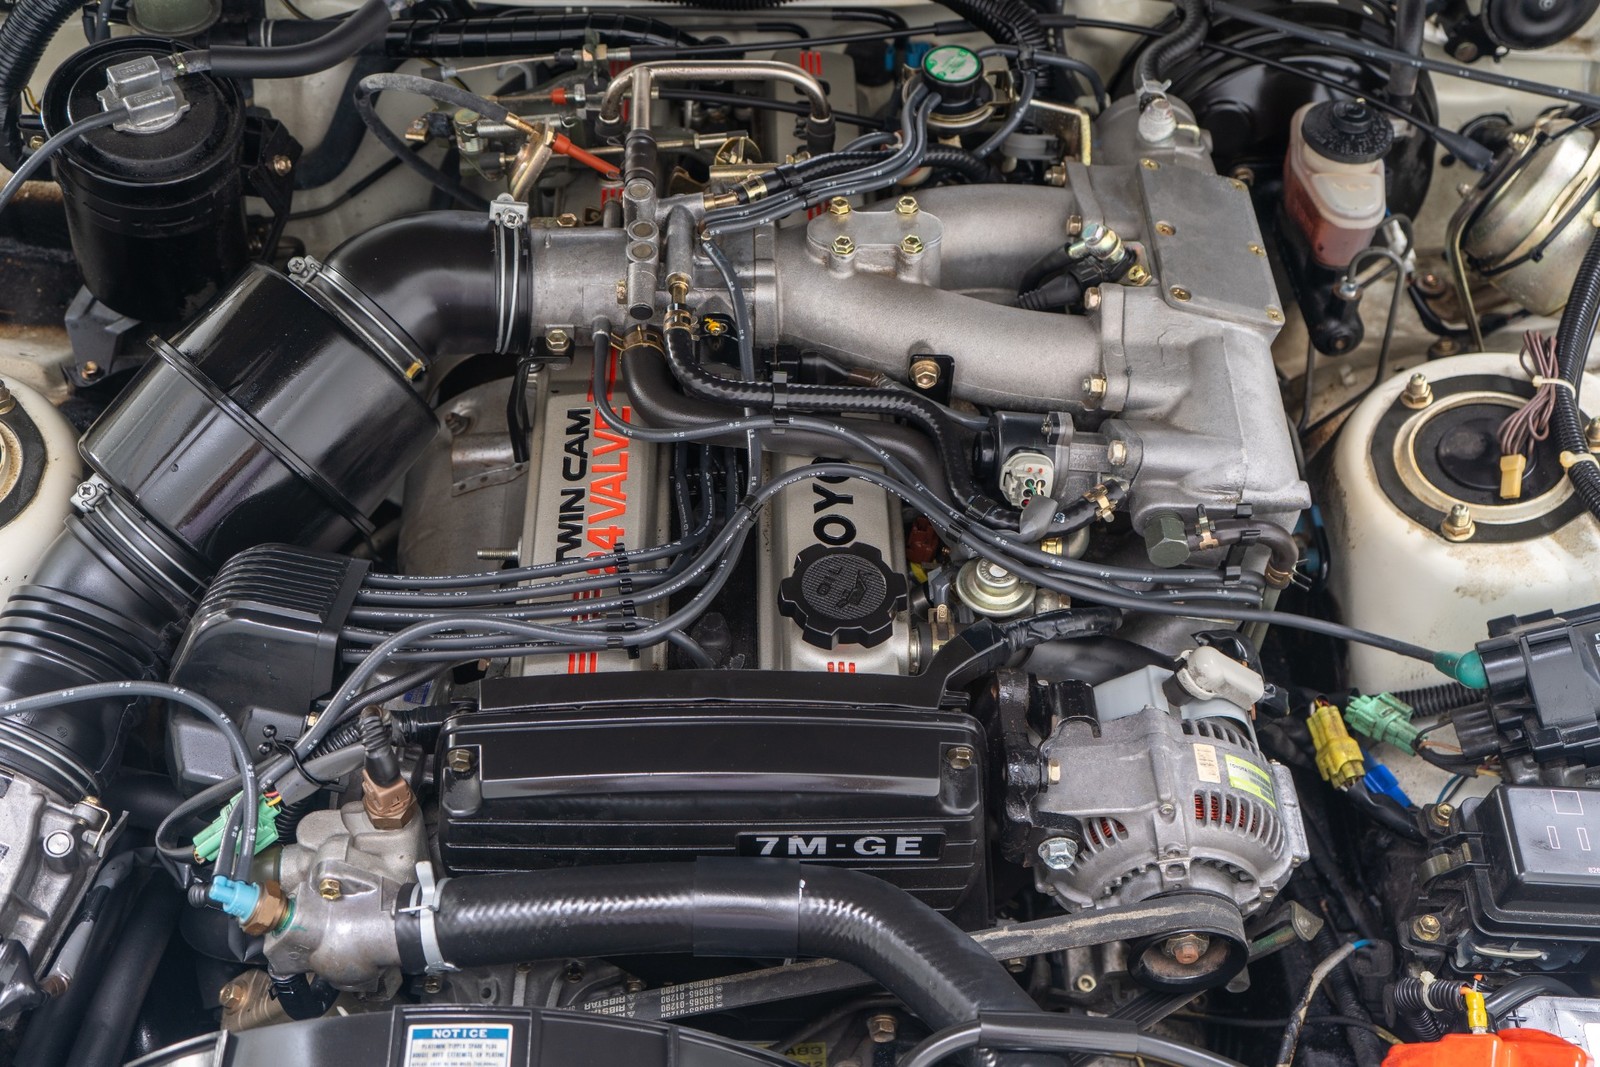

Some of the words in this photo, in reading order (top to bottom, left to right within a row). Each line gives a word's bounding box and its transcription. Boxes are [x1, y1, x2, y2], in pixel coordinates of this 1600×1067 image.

[562, 408, 591, 481] CAM
[755, 836, 923, 856] 7M-GE
[584, 995, 626, 1010] RIBSTAR
[432, 1029, 488, 1038] NOTICE
